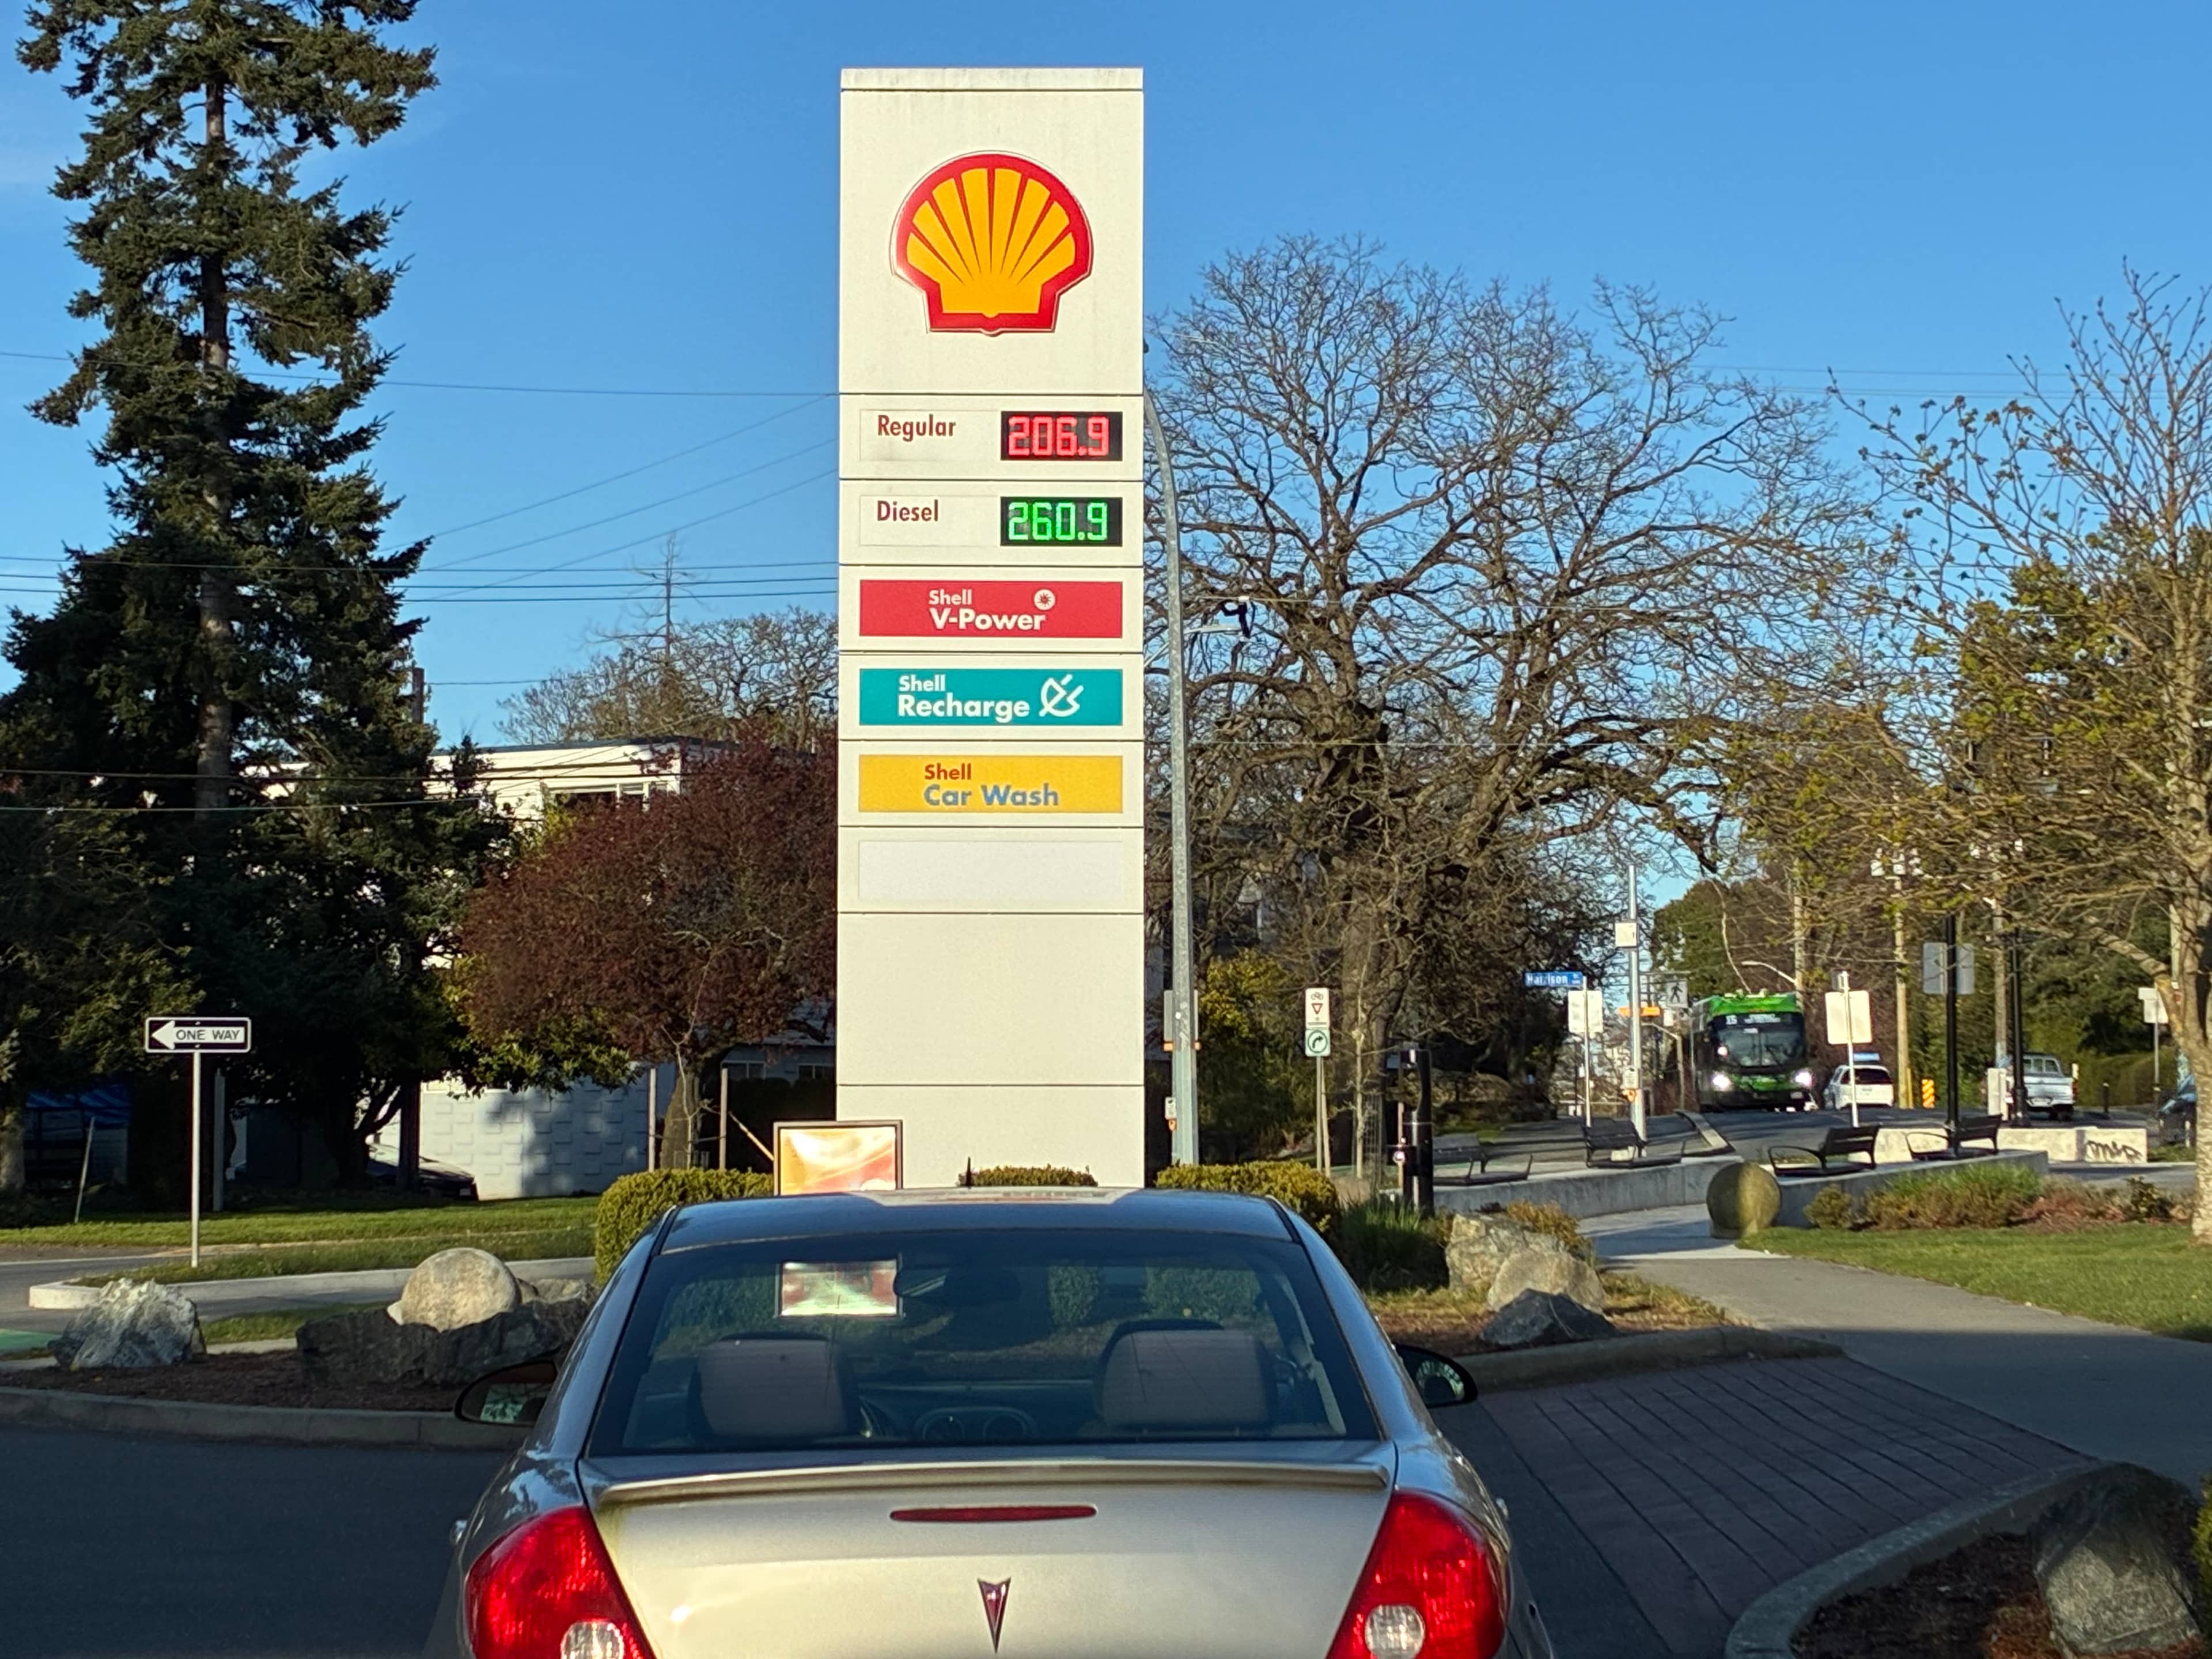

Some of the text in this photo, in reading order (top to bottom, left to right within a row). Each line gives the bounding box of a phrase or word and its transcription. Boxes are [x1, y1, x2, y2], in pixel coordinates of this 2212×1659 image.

[877, 414, 956, 442] Regular
[1008, 416, 1109, 456] 206.9
[877, 499, 939, 522] Diesel
[1008, 501, 1108, 540] 260.9
[929, 589, 972, 605] Shell
[929, 608, 1047, 631] V-Power
[898, 674, 946, 692] Shell
[897, 692, 1030, 723] Recharge
[924, 763, 972, 781] Shell
[923, 782, 1059, 806] Car Wash
[176, 1029, 240, 1040] ONE WAY
